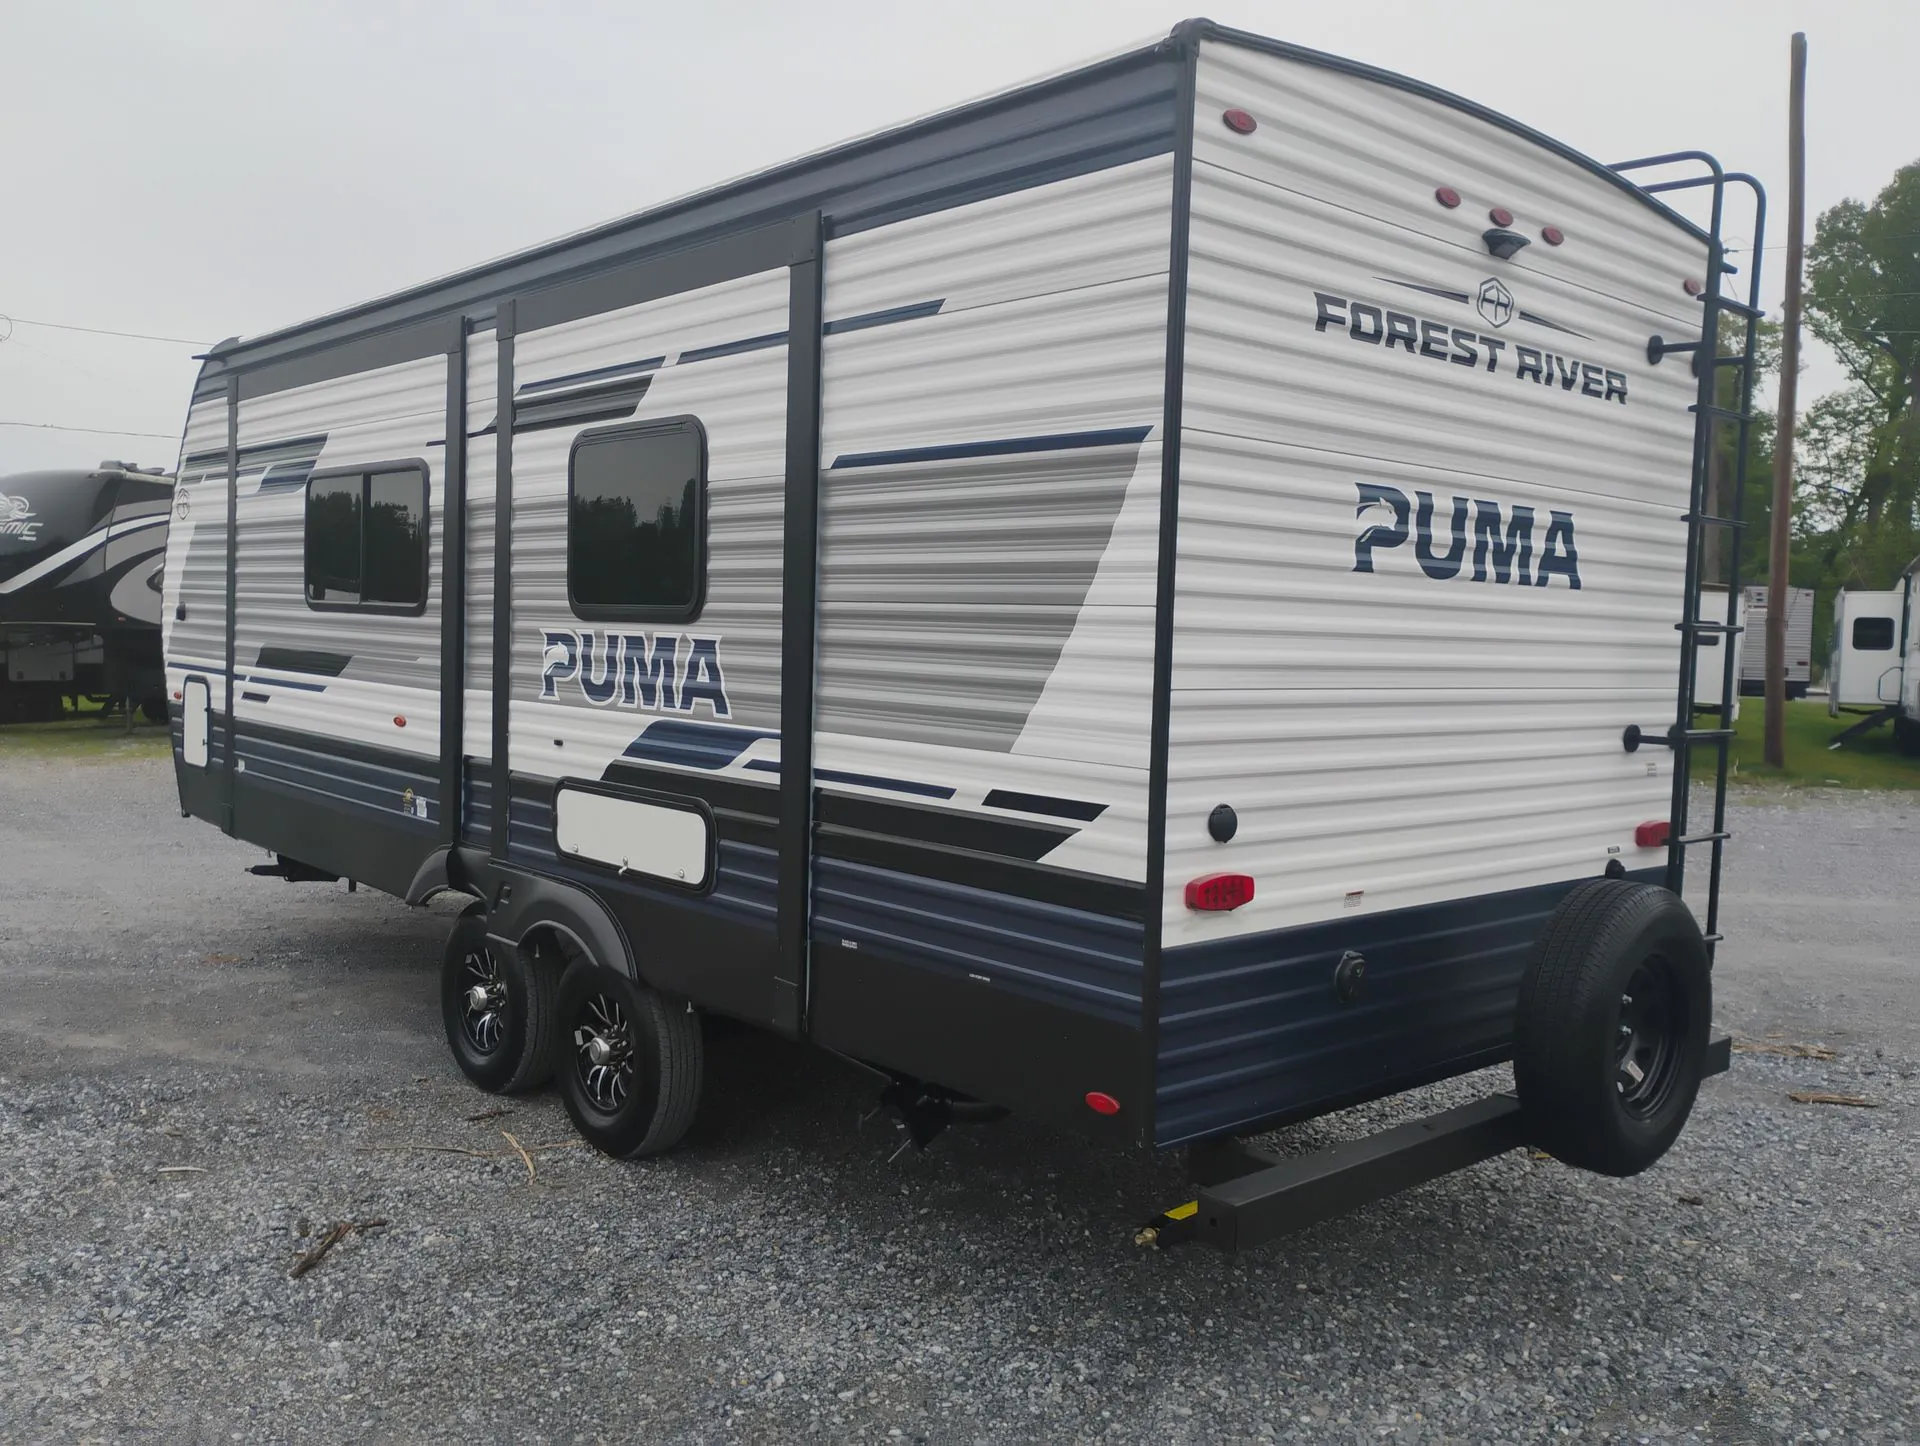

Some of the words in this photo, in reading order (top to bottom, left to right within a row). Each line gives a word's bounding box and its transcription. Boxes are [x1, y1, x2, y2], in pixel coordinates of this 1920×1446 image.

[1313, 291, 1506, 373] FOREST
[1515, 344, 1628, 404] RIVER
[1351, 482, 1582, 590] PUMA
[538, 628, 732, 719] PUMA
